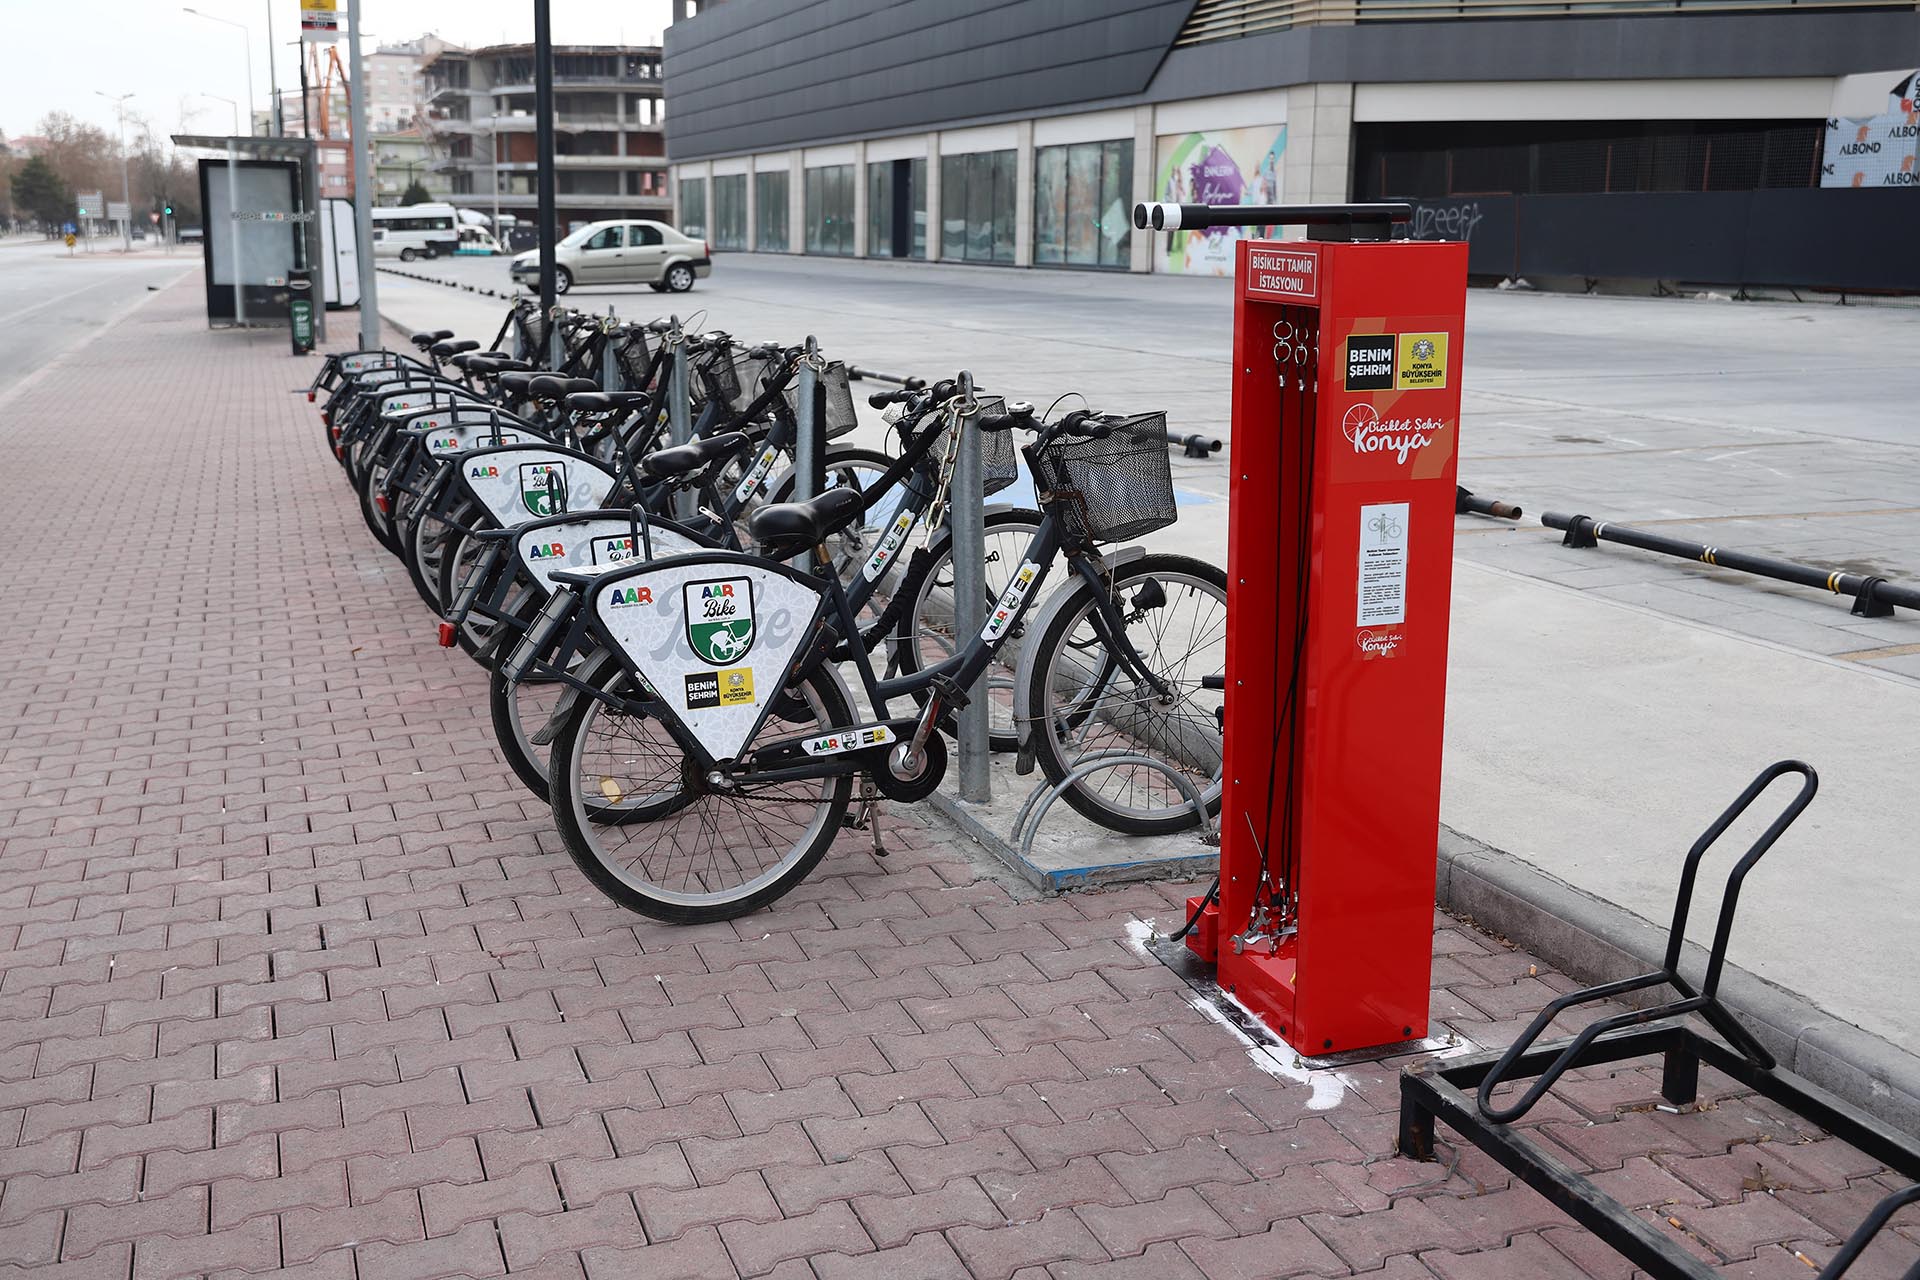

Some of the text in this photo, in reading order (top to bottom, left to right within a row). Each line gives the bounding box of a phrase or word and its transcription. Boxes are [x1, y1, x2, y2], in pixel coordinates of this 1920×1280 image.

[1839, 143, 1881, 155] ALBOND
[1252, 253, 1312, 274] BİSİKLET TAMİR
[1259, 271, 1303, 292] İSTASYONU
[1368, 417, 1444, 433] Bisiklet Şehri
[434, 438, 458, 448] AAR
[1354, 426, 1432, 465] Konya
[471, 466, 499, 477] AAR
[530, 542, 566, 559] AAR
[871, 551, 888, 571] AAR
[610, 586, 654, 606] AAR
[701, 584, 735, 599] AAR
[702, 598, 737, 618] Bike
[989, 610, 1008, 634] AAR
[1362, 638, 1398, 657] Konya
[813, 738, 839, 752] AAR
